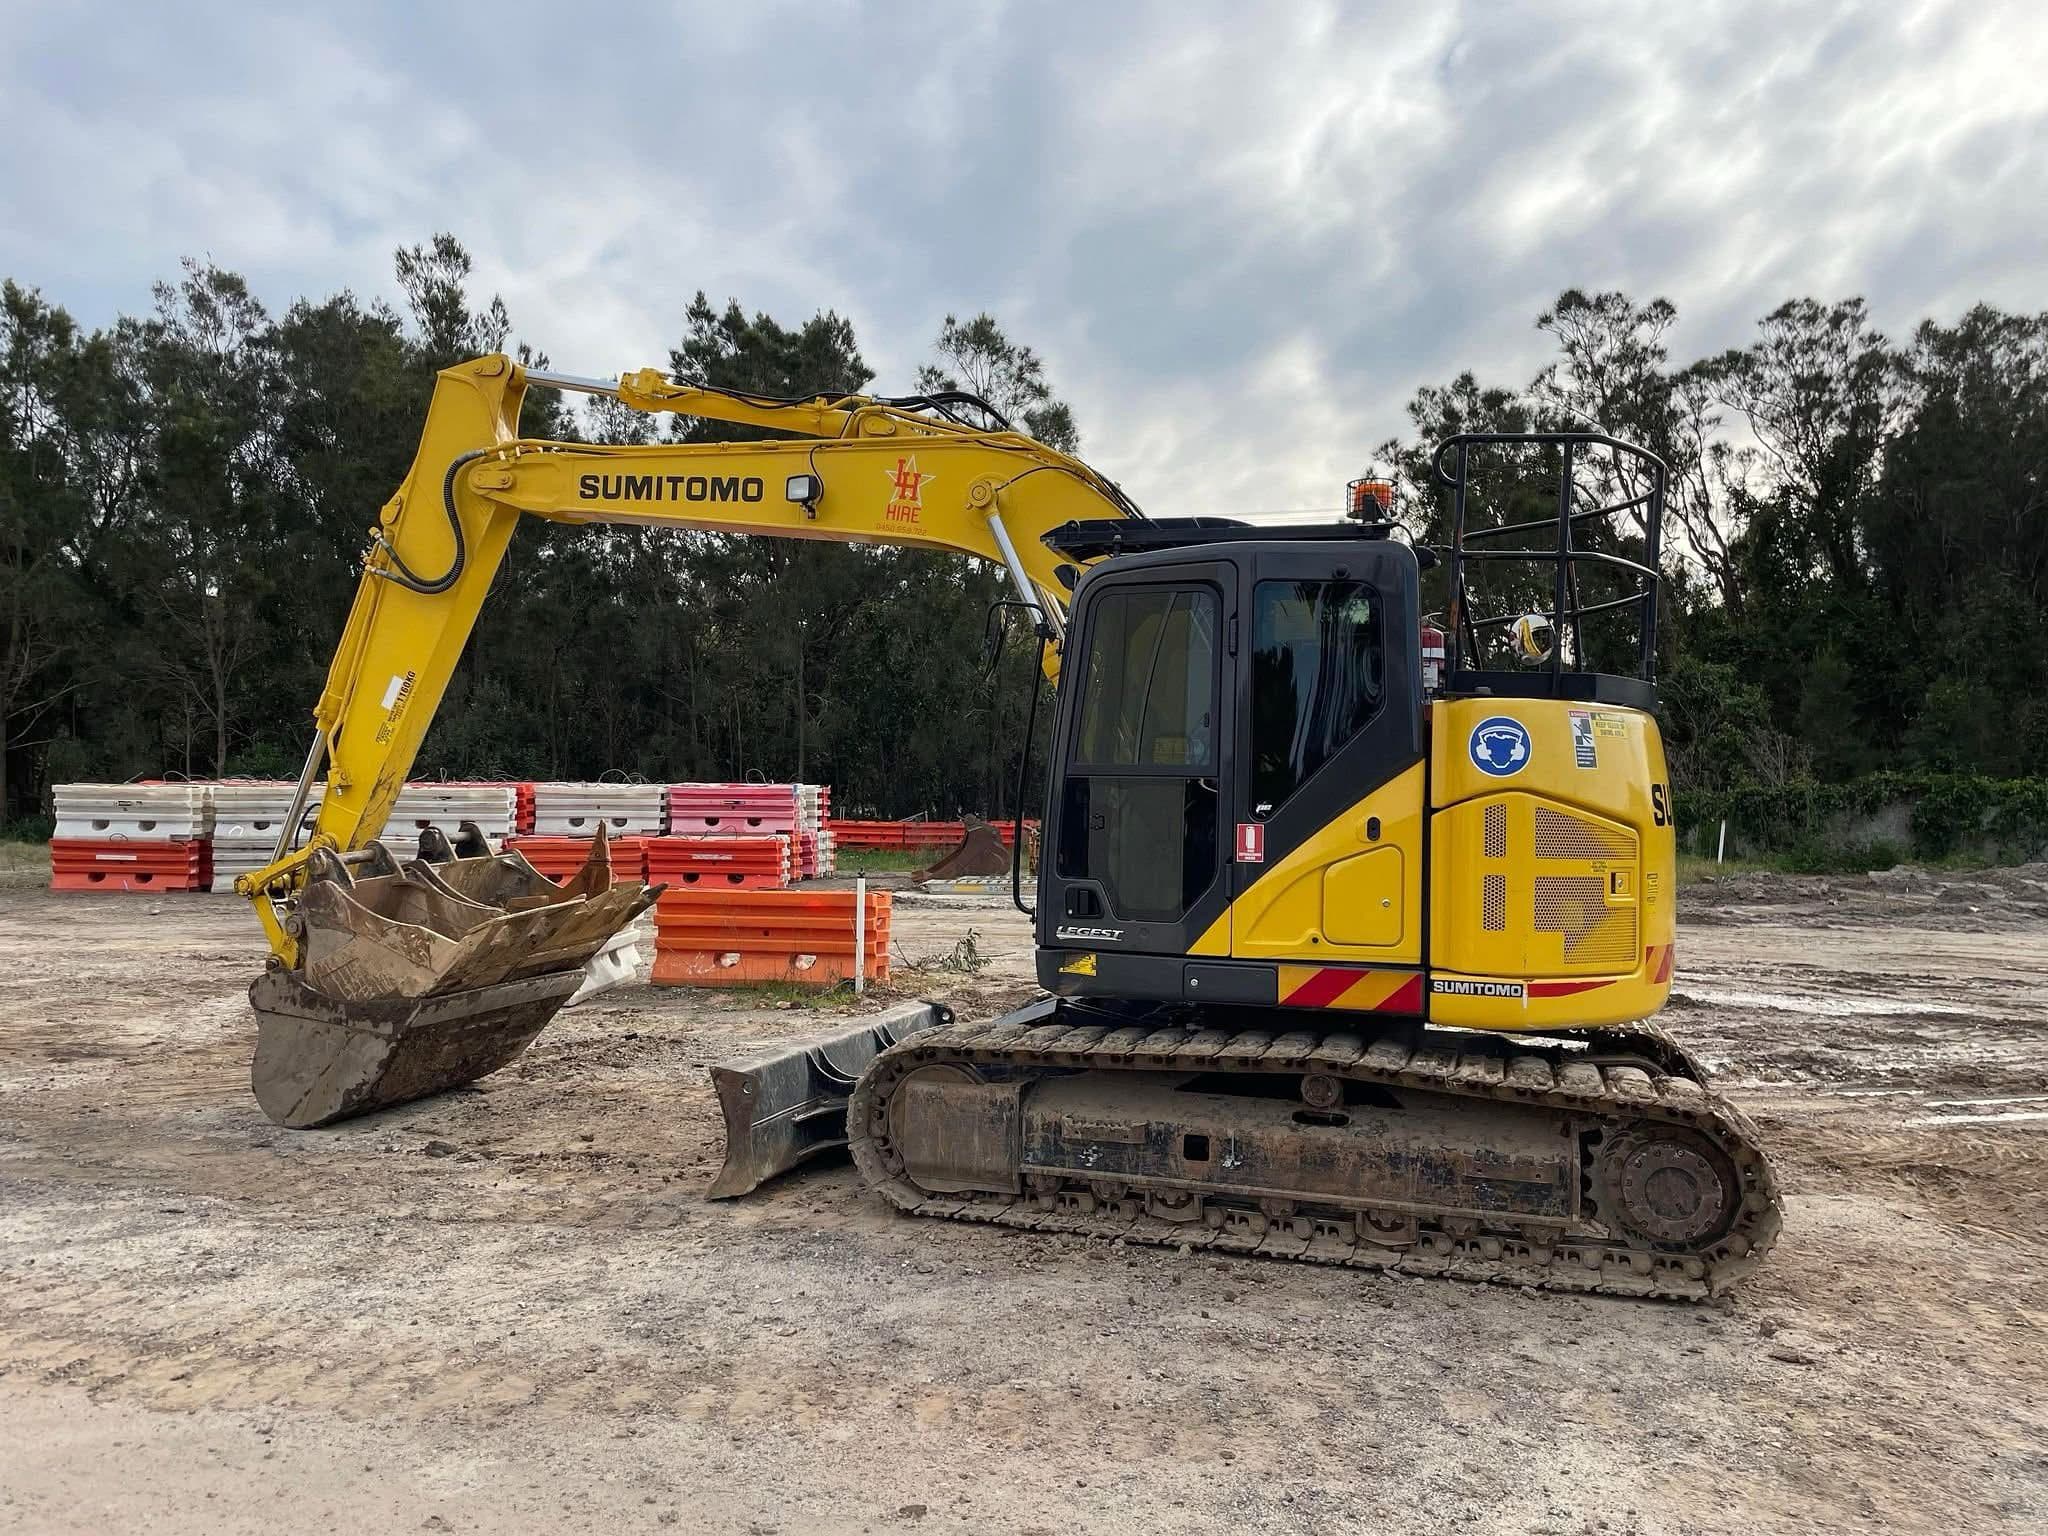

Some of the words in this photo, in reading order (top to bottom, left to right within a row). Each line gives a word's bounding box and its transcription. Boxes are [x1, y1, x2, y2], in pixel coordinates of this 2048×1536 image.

[579, 475, 764, 502] SUMITOMO
[886, 504, 921, 523] HIRE
[397, 670, 416, 702] 1160KG
[1056, 926, 1124, 939] LEGEST
[1433, 981, 1522, 997] SUMITOMO
